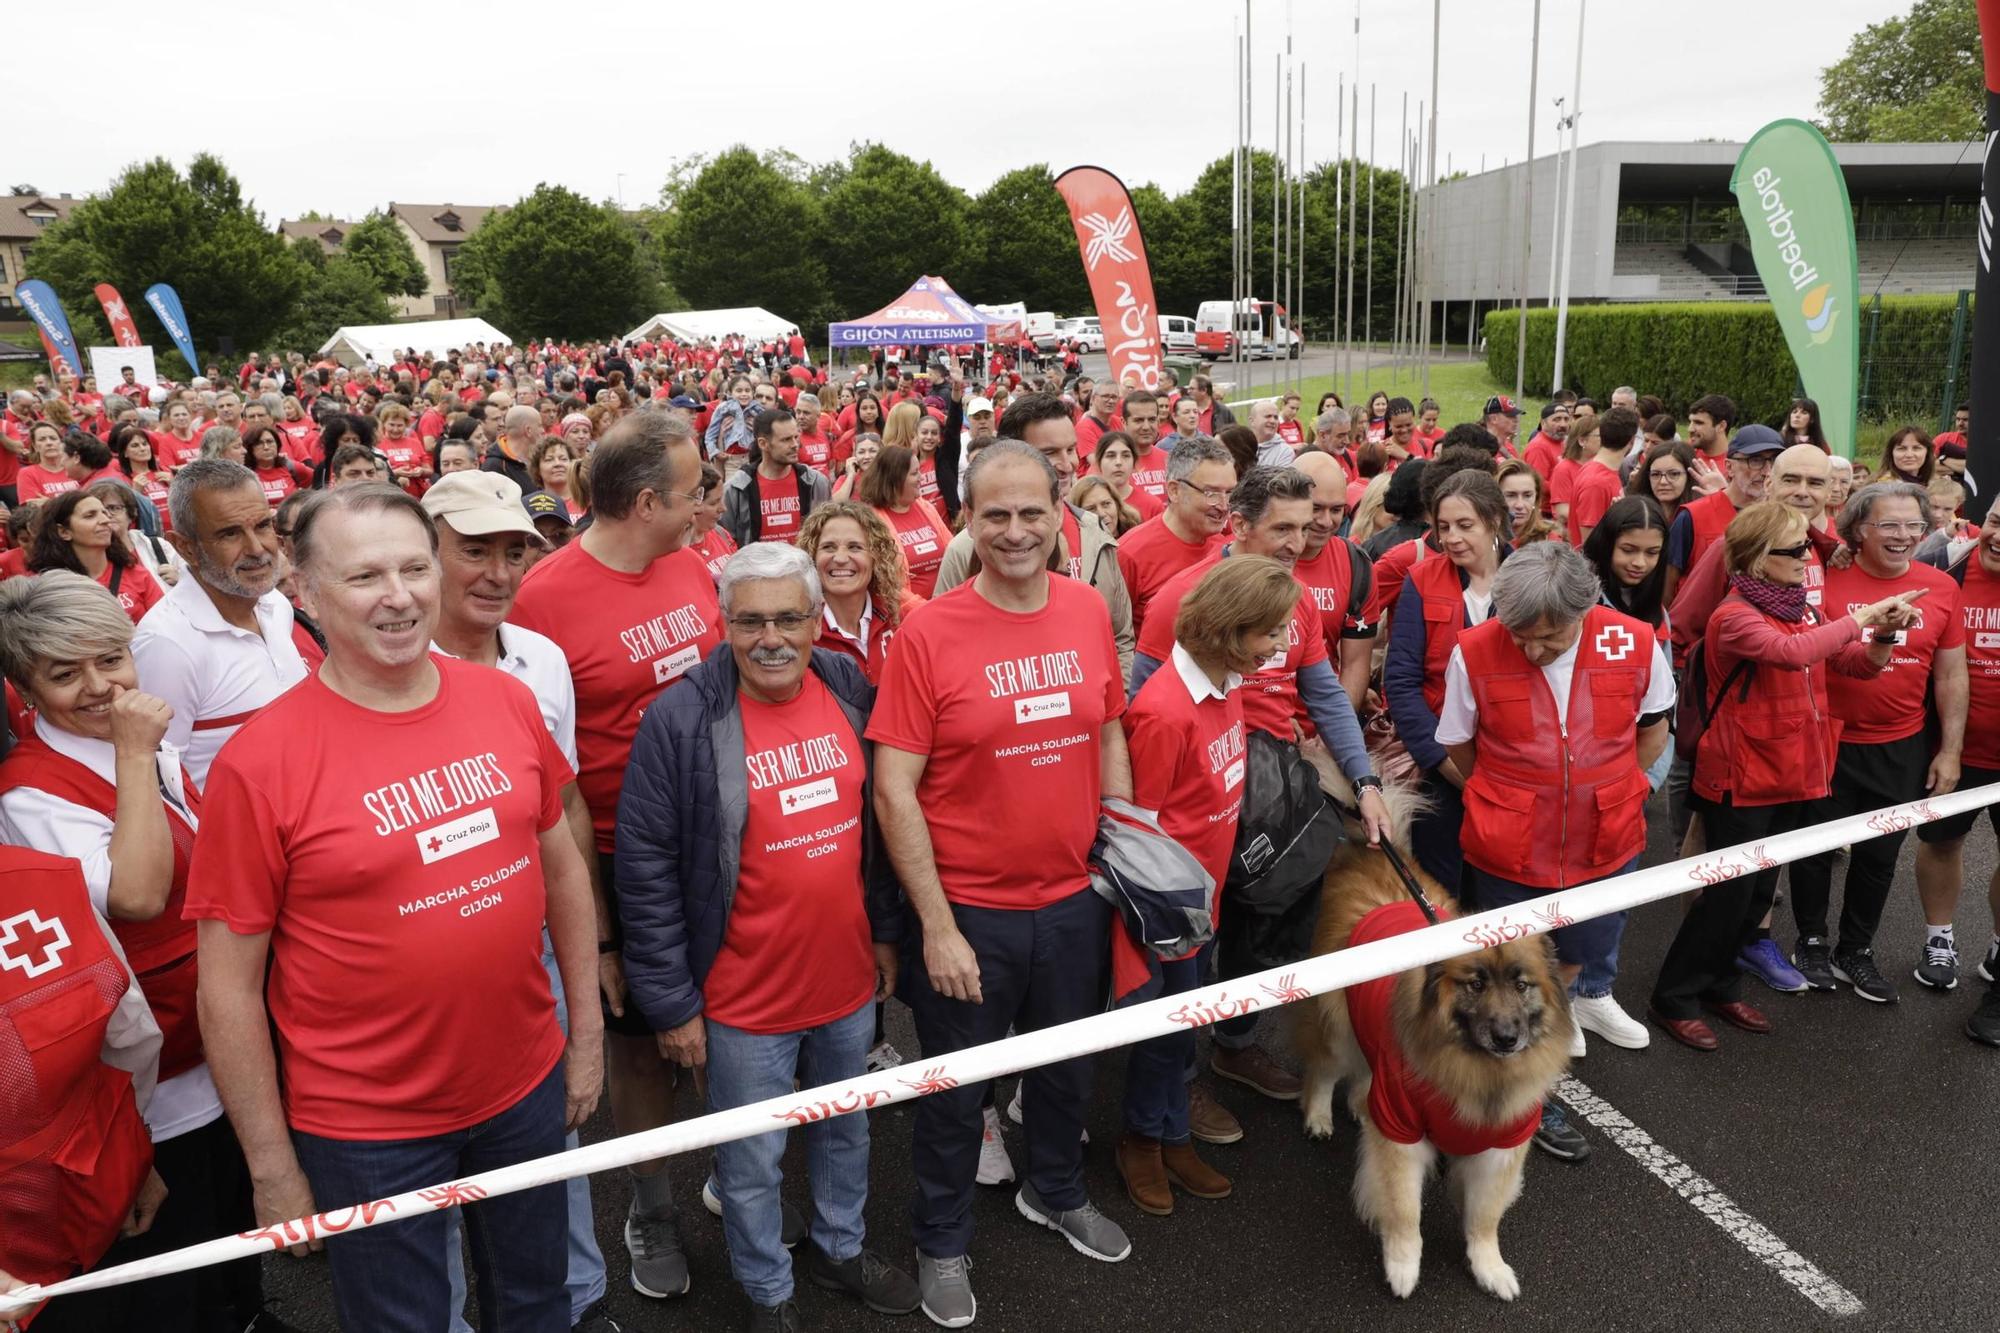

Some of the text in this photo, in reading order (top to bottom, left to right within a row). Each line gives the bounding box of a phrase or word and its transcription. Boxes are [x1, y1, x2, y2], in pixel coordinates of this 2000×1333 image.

[843, 325, 973, 343] GIJÓN ATLETISMO
[770, 496, 801, 514] MEJORES
[620, 604, 707, 663] SER MEJORES
[1890, 657, 1920, 665] LIDARIA
[985, 650, 1083, 698] SER MEJORES
[1033, 701, 1065, 712] Cruz Roja
[995, 733, 1090, 758] MARCHA SOLIDARIA
[1208, 739, 1225, 774] SER
[745, 733, 848, 790] SER MEJORES
[1031, 753, 1062, 767] GIJÓN
[363, 752, 512, 837] SER MEJORES
[799, 786, 832, 802] Cruz Roja
[446, 820, 491, 844] Cruz Roja
[1866, 809, 1914, 834] gijón
[765, 834, 815, 853] MARCHA
[807, 842, 838, 859] GIJÓN
[1688, 856, 1747, 885] gijón
[398, 855, 531, 916] MARCHA SOLIDARIA
[459, 891, 503, 918] GIJÓN
[1462, 915, 1536, 949] gijón
[1166, 992, 1260, 1029] gijón
